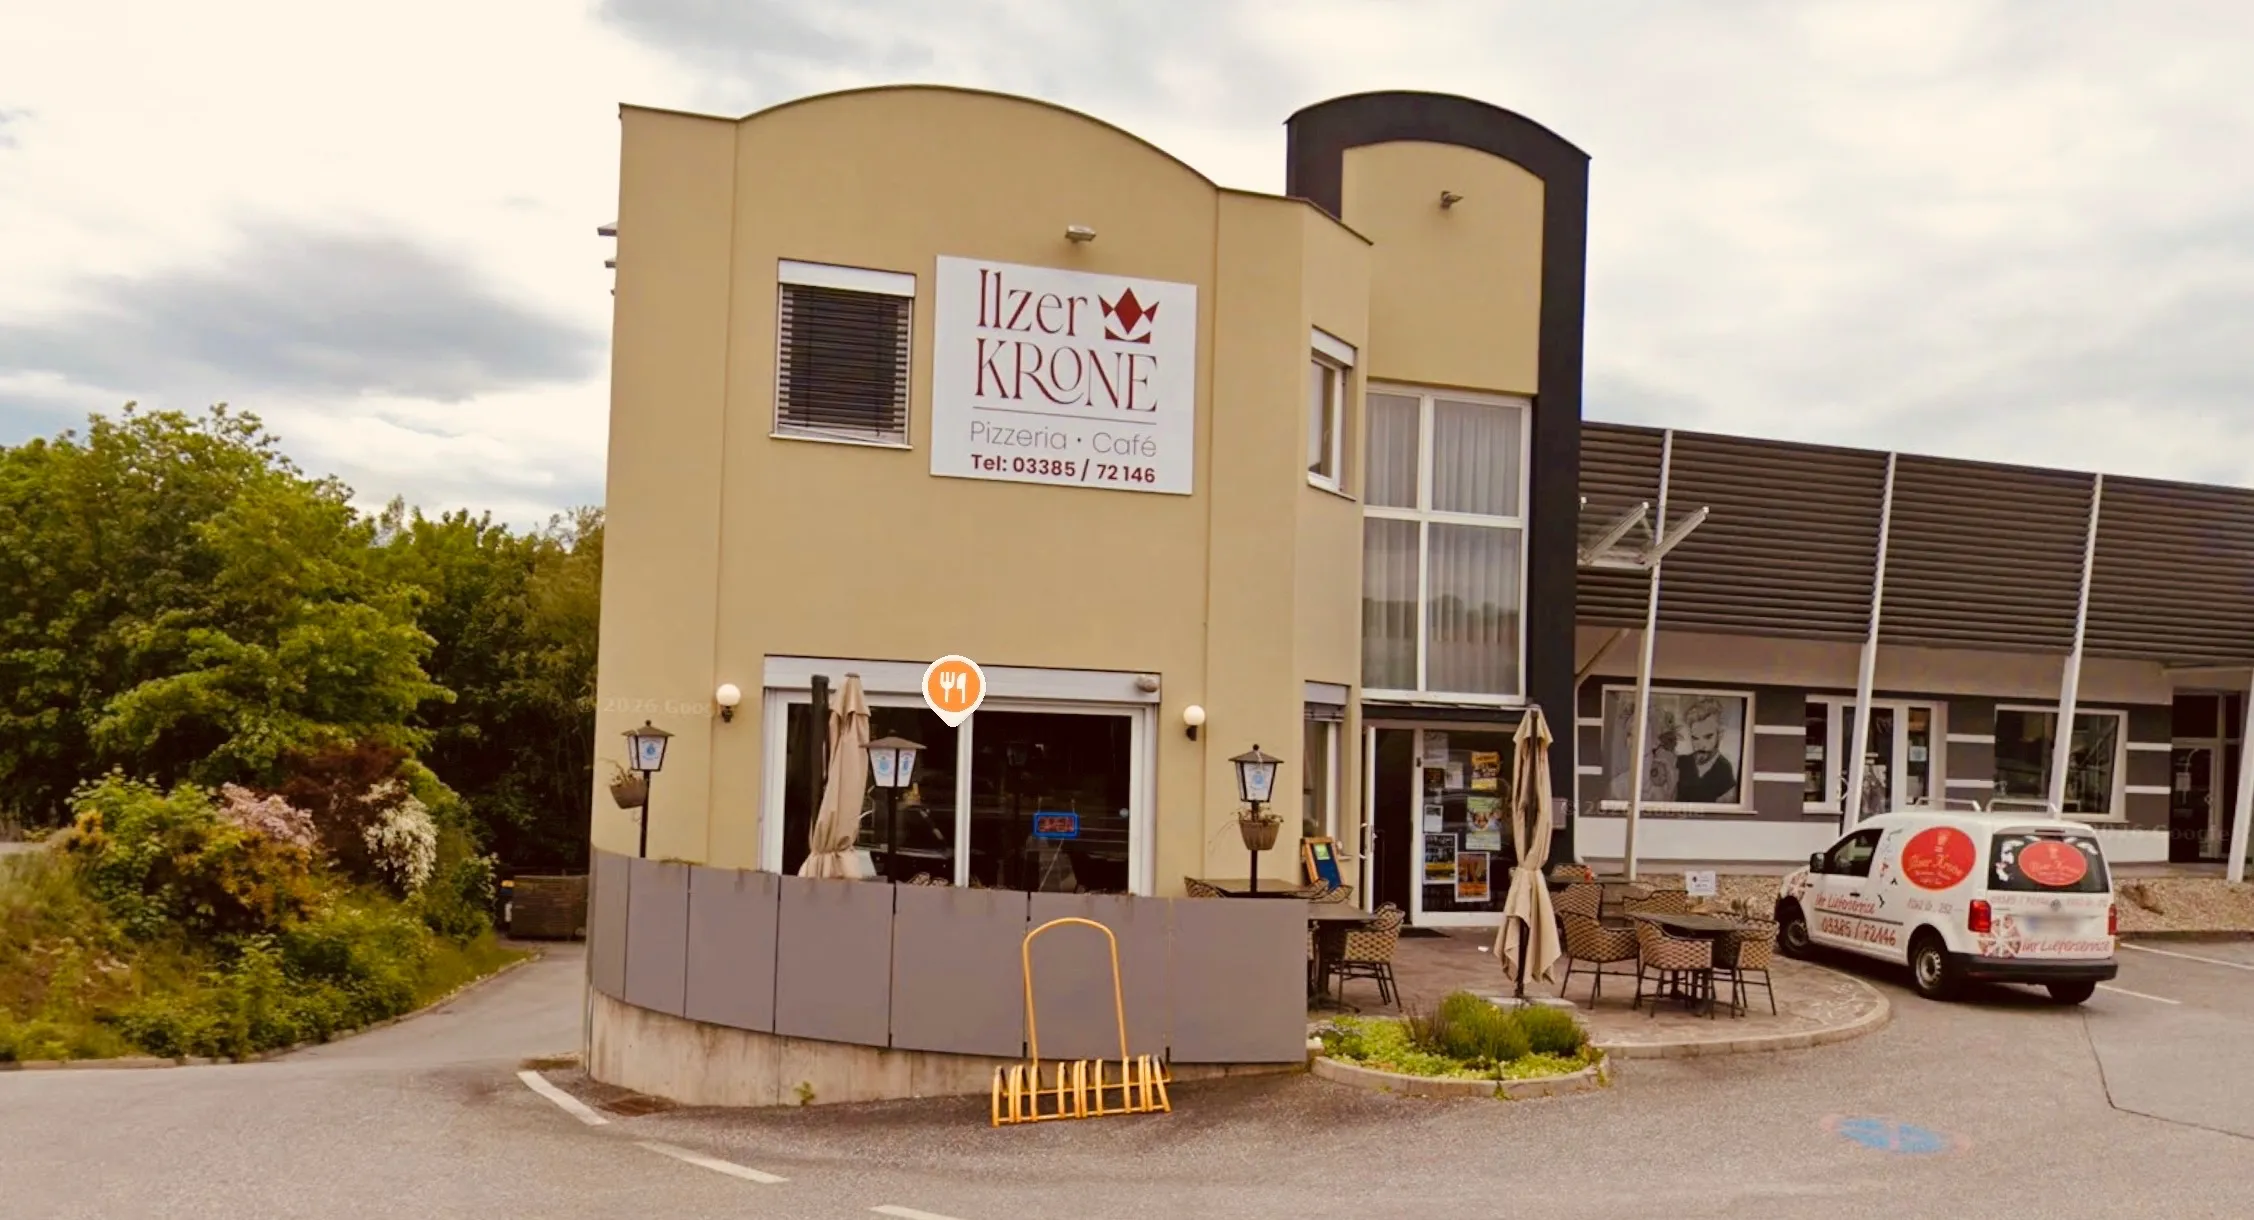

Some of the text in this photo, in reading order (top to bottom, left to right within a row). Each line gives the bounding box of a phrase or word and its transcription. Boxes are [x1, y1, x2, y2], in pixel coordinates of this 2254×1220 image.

[976, 268, 1088, 337] Ilzer
[975, 337, 1158, 412] KRONE
[970, 420, 1067, 450] Pizzeria
[1092, 431, 1157, 458] Café
[971, 454, 1007, 472] Tel:
[1013, 457, 1076, 477] 03385
[1080, 458, 1090, 482] /
